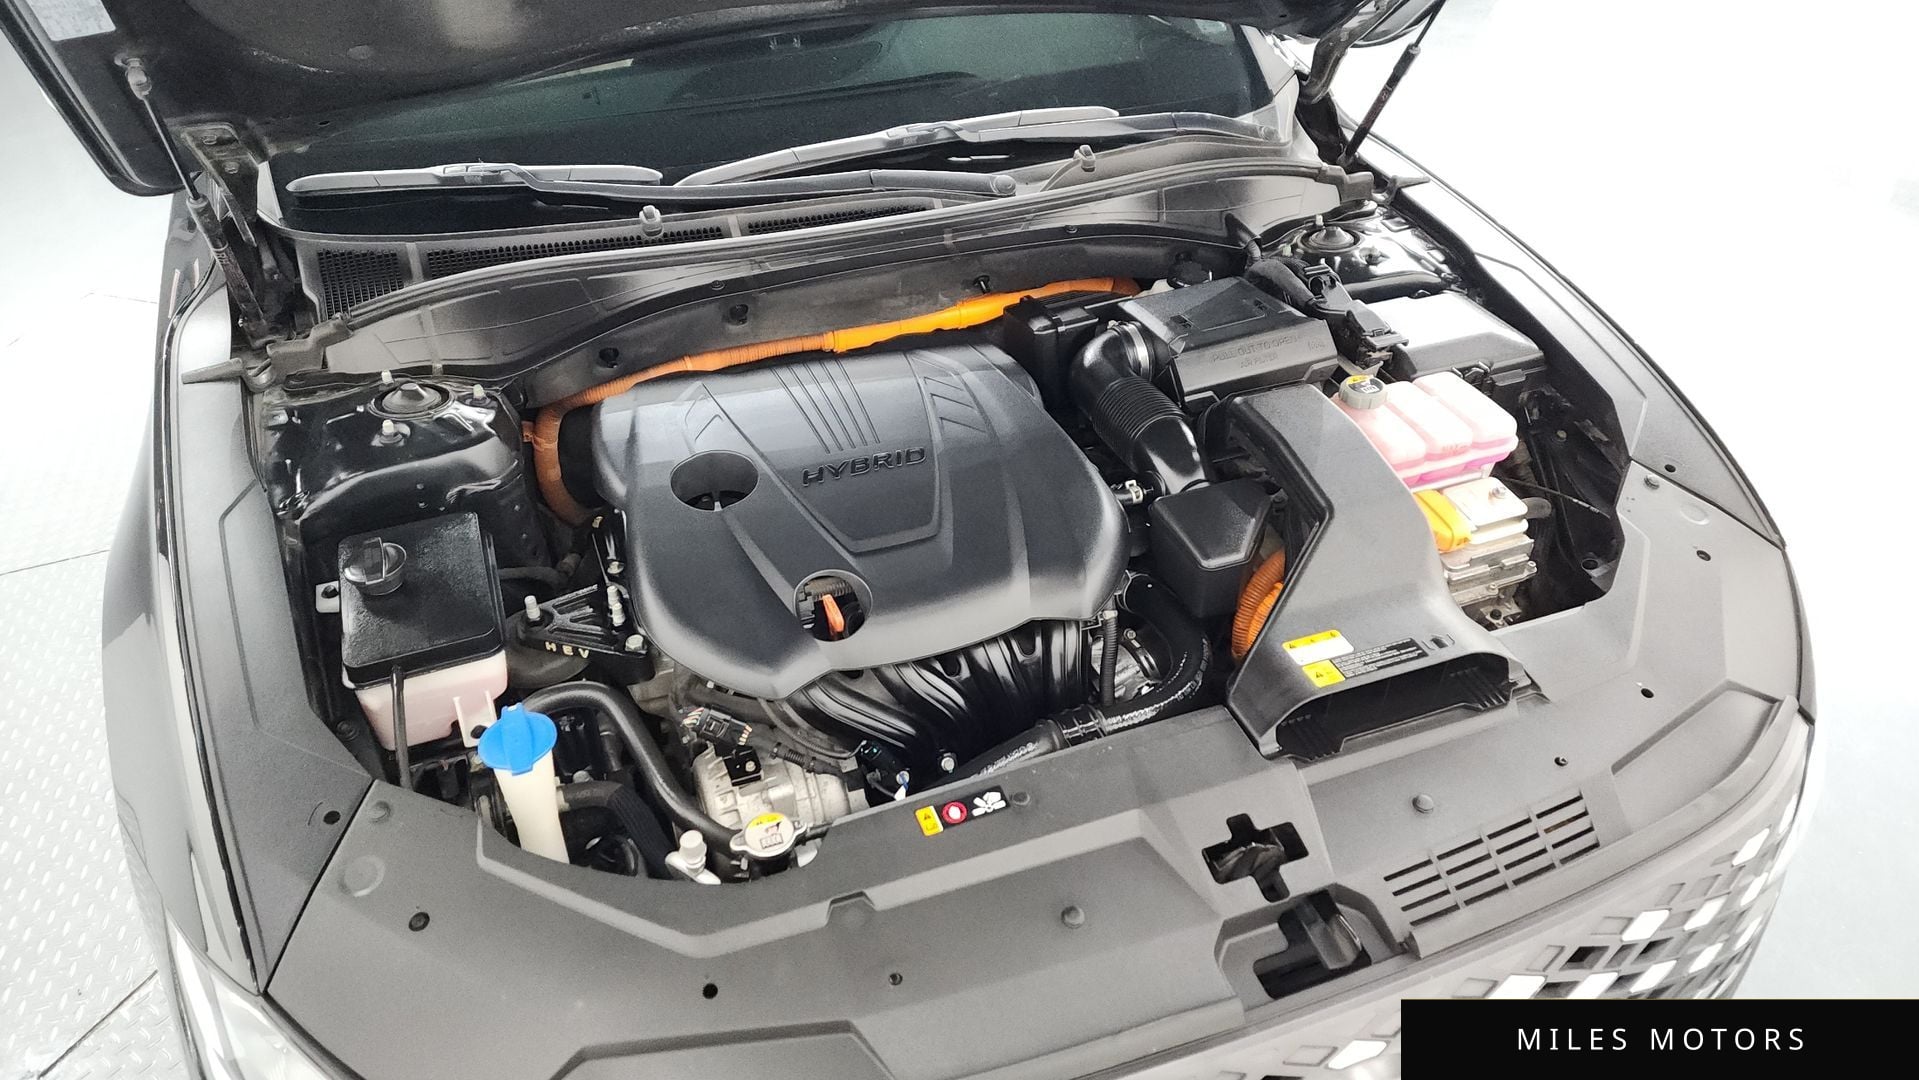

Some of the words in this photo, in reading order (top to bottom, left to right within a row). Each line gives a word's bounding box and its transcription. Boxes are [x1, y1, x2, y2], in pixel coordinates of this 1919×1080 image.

[1238, 344, 1256, 356] OUT
[1258, 341, 1271, 351] TO
[802, 447, 926, 487] HYBRID
[545, 641, 589, 659] HEV
